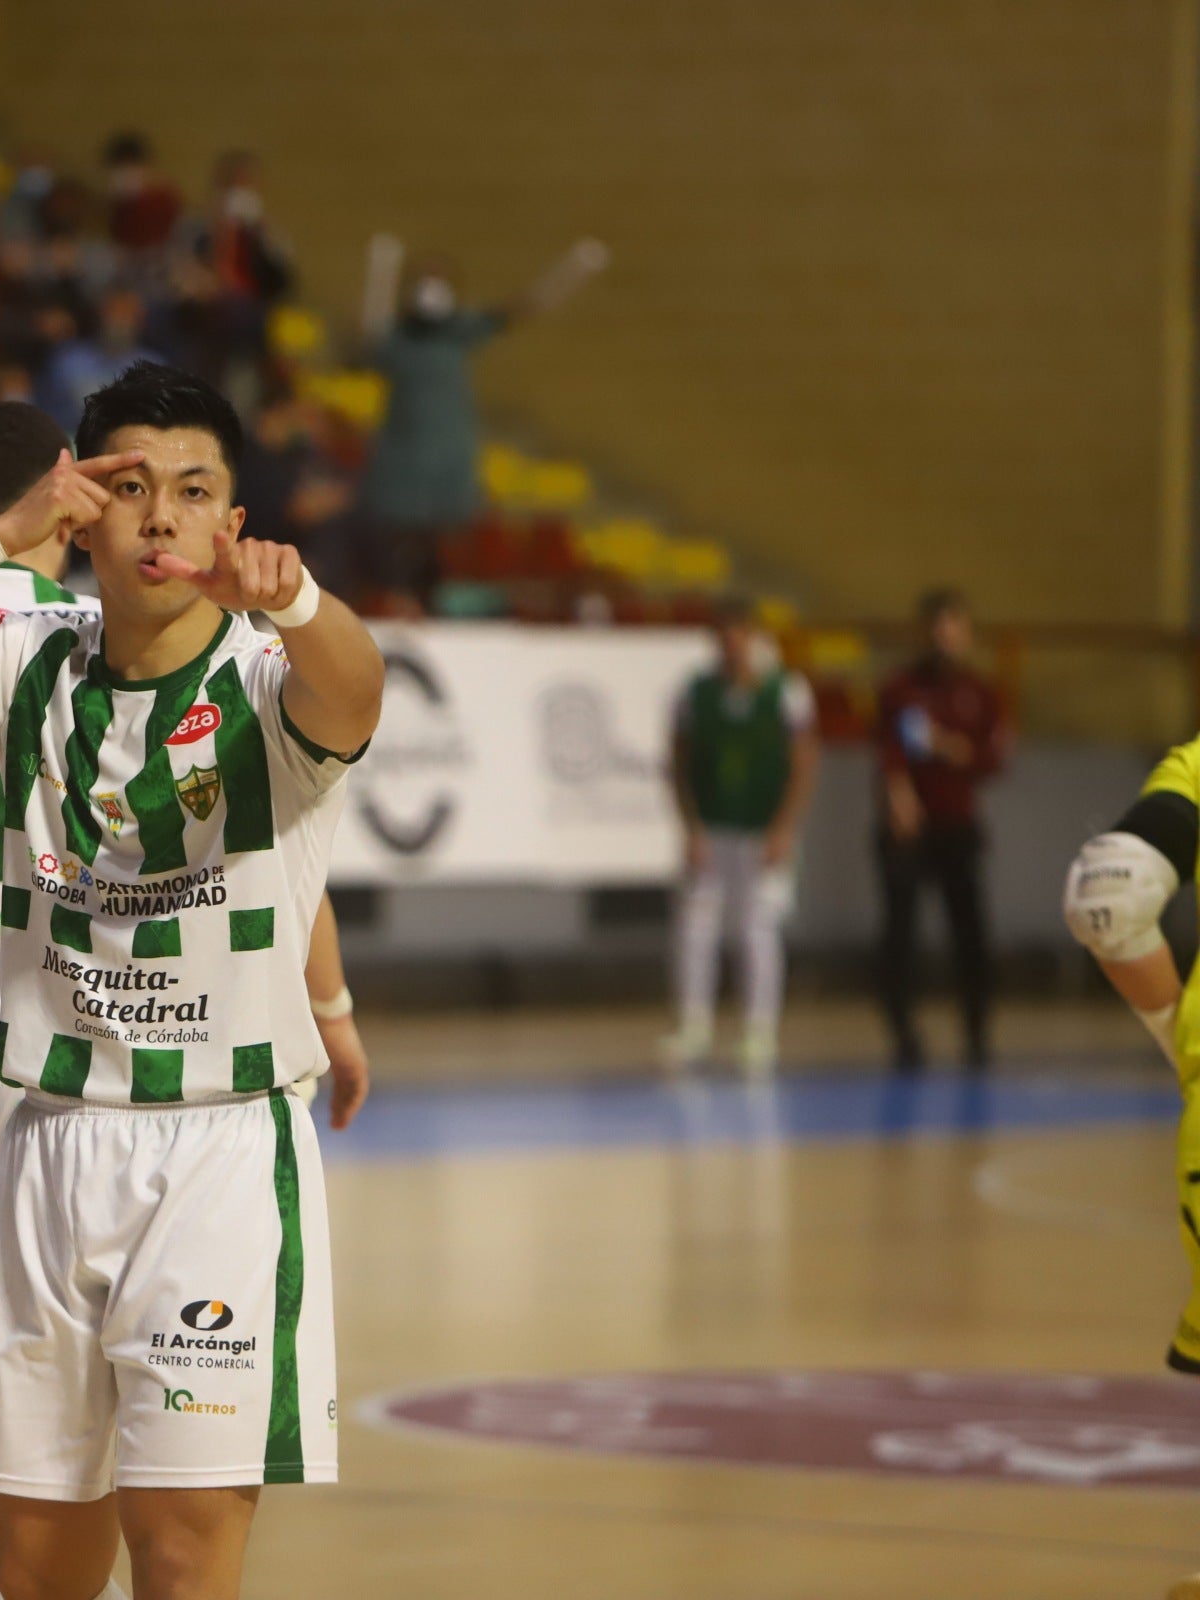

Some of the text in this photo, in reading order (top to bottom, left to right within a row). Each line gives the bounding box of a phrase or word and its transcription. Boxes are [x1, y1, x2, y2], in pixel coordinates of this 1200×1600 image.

[169, 710, 215, 738] eza
[32, 865, 225, 906] RDOBA PATRIMONO DE LA
[101, 885, 227, 917] HUMANDAD
[42, 945, 179, 994] Mezquita-
[72, 993, 209, 1024] Catedral
[75, 1018, 209, 1044] Corazón de Córdoba
[150, 1333, 256, 1356] El Arcángel
[148, 1354, 255, 1370] CENTRO COMERCIAL
[163, 1388, 237, 1415] 10 METROS
